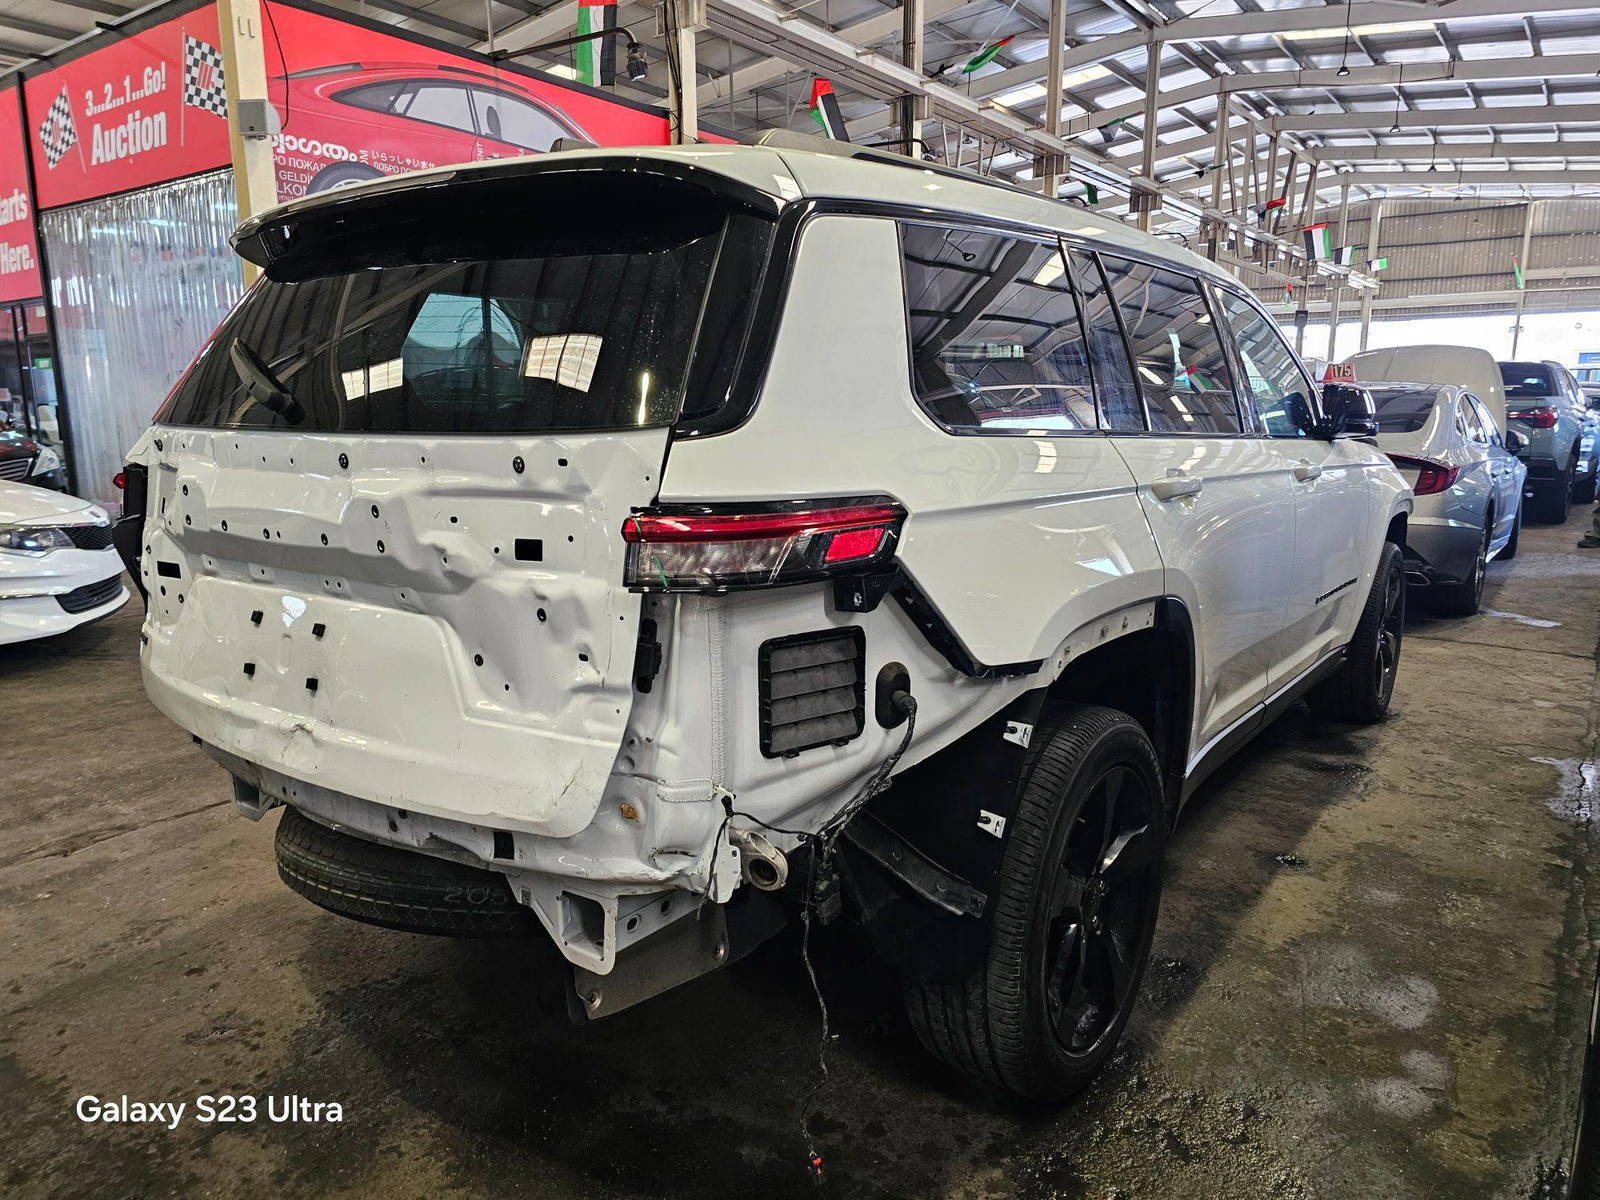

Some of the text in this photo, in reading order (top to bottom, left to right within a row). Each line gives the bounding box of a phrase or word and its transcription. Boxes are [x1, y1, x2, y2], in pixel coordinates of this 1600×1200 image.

[91, 110, 168, 166] Auction
[0, 188, 28, 226] arts
[0, 241, 35, 275] Here.
[1333, 364, 1352, 377] 175
